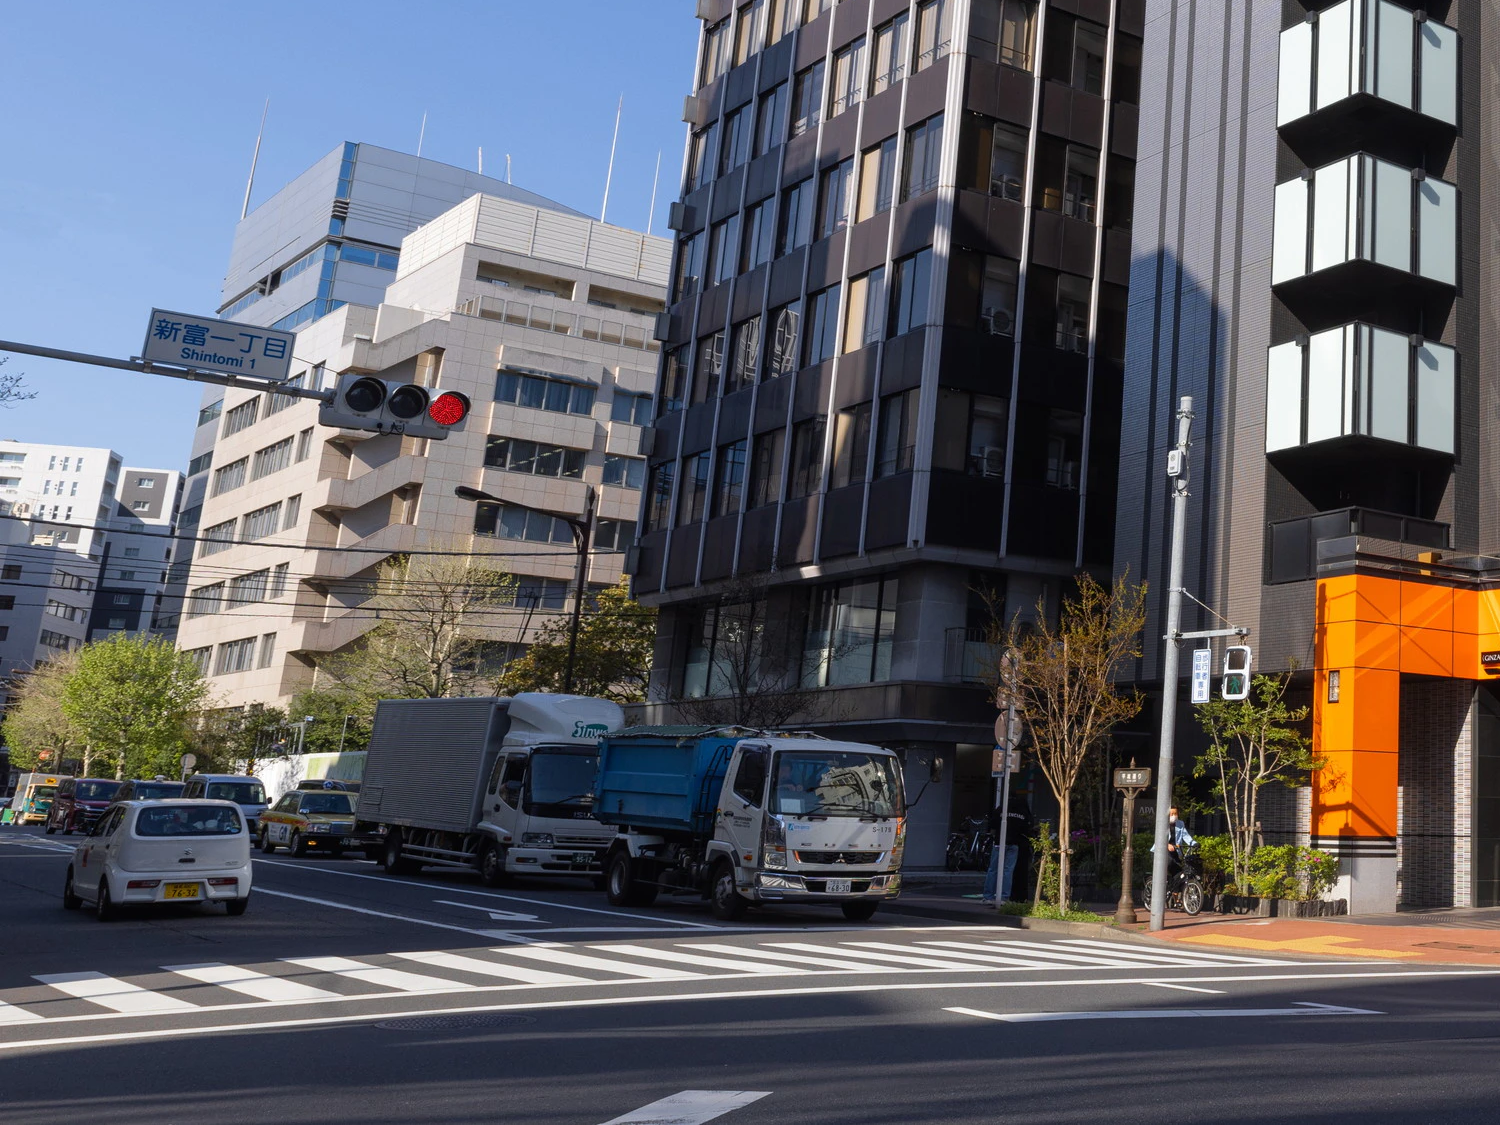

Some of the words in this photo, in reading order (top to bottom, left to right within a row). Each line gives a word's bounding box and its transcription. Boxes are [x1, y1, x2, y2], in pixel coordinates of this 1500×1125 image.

[153, 318, 287, 359] 新富一丁目
[181, 347, 244, 368] Shintomi
[249, 358, 256, 369] 1
[1139, 806, 1156, 815] APA
[831, 884, 850, 892] 68-30
[172, 889, 197, 897] 76-32
